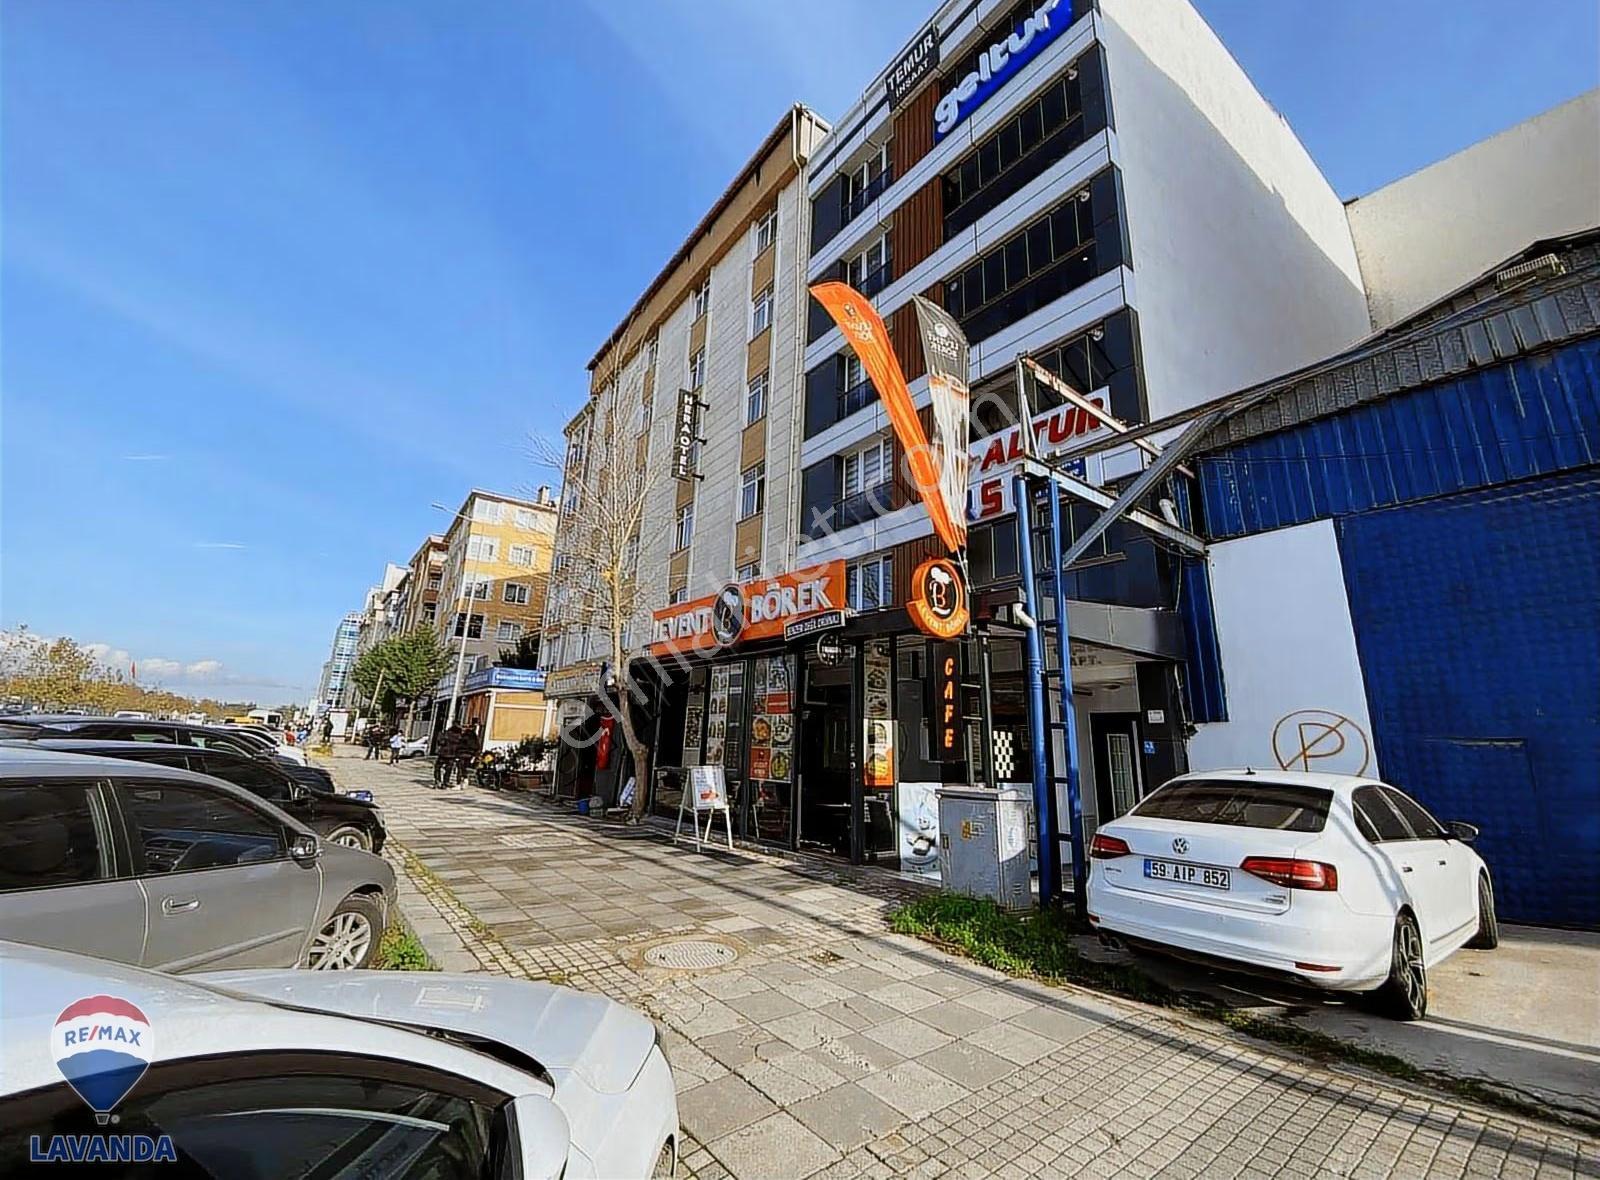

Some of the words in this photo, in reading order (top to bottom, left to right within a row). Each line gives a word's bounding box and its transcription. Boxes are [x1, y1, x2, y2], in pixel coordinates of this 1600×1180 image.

[887, 33, 934, 91] TEMUR
[750, 577, 834, 624] BÖREK
[652, 606, 714, 643] LEVENT
[944, 658, 954, 748] CAFE
[1151, 862, 1167, 878] 59
[1173, 864, 1196, 881] AIP
[1203, 869, 1227, 886] 852
